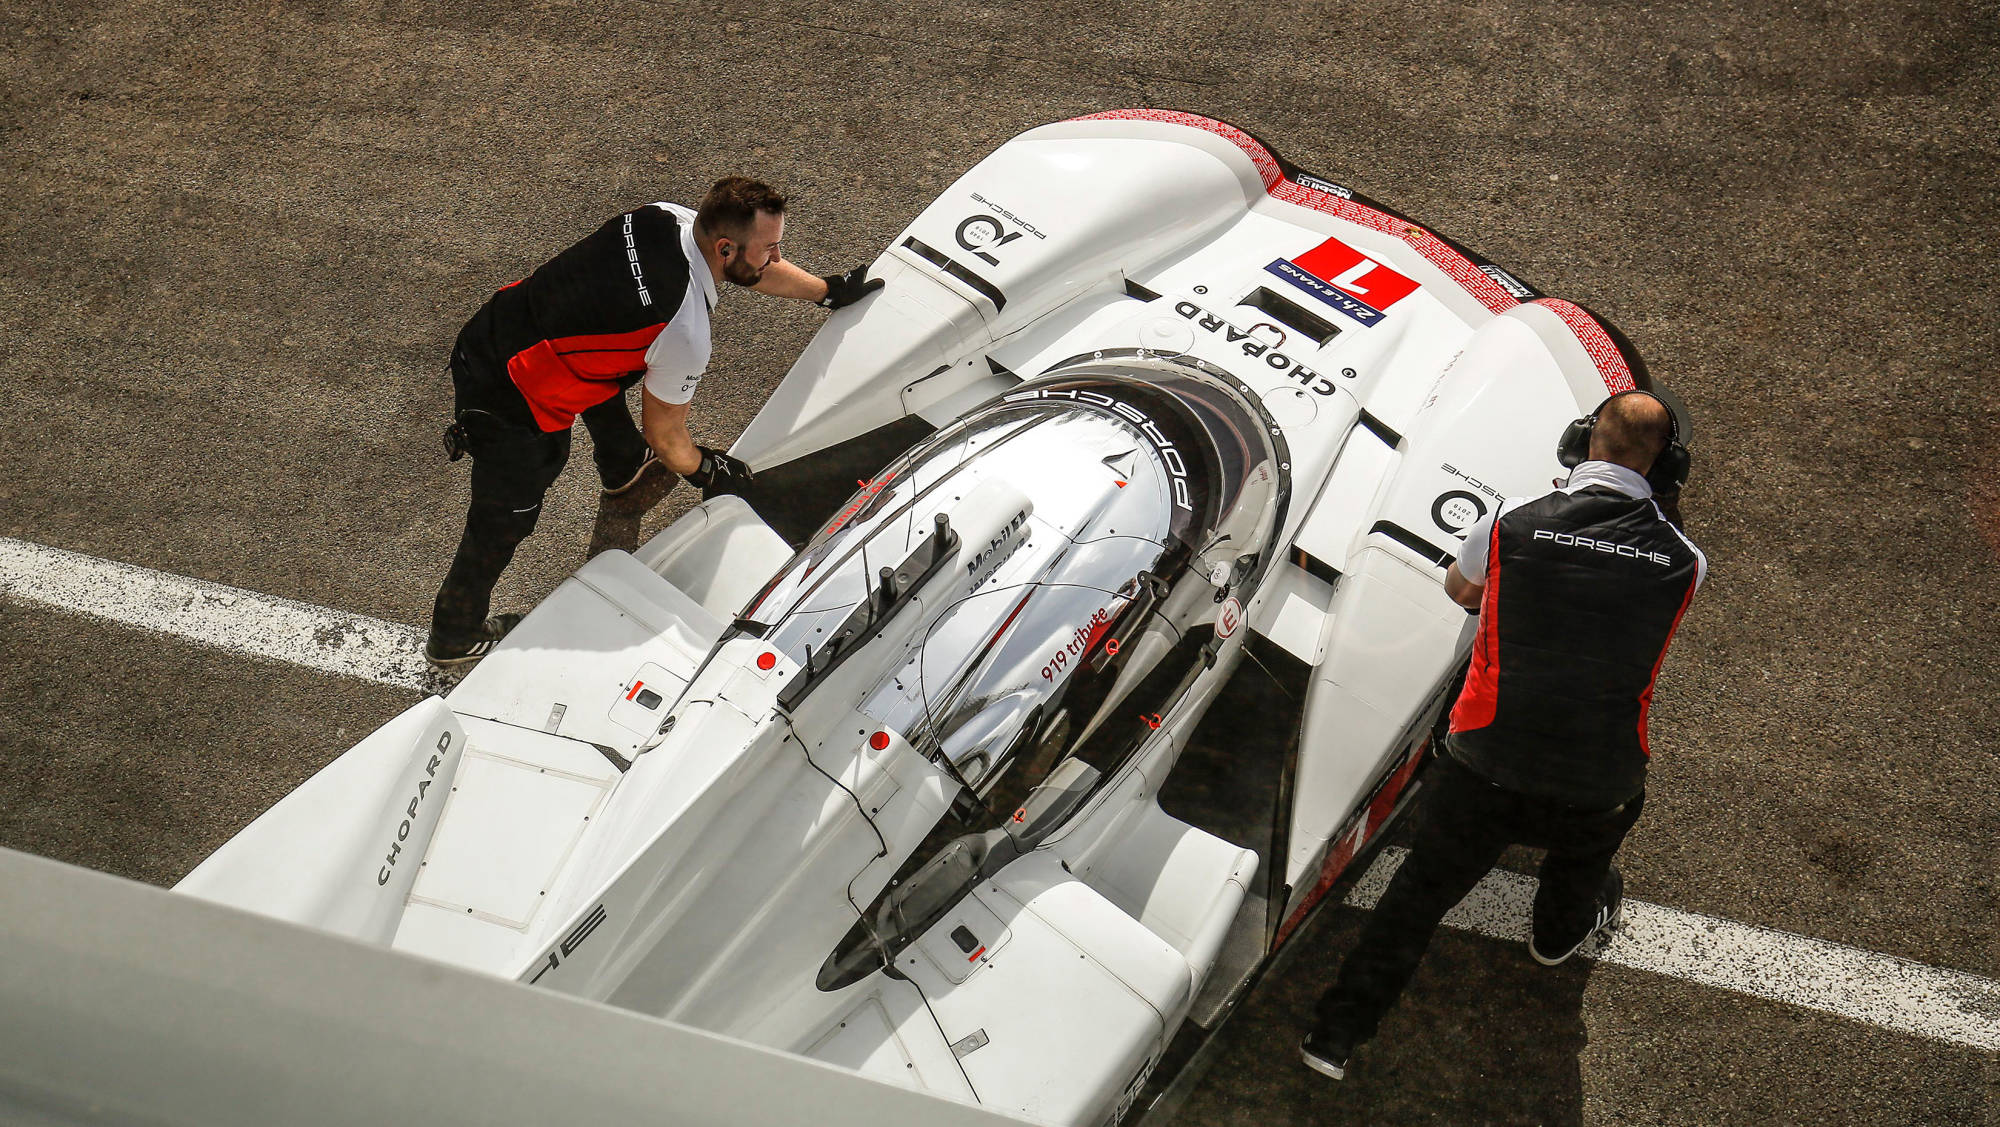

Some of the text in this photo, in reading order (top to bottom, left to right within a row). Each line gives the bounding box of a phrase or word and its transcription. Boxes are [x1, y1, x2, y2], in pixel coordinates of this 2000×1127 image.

[970, 192, 1047, 240] PORSCHE
[623, 213, 652, 307] PORSCHE
[1278, 263, 1323, 290] MANS
[1328, 258, 1379, 295] 1
[1321, 288, 1344, 301] LE
[1174, 301, 1337, 396] CHOPARD
[1003, 389, 1193, 511] PORSCHE
[967, 525, 1011, 577] Mobil
[1533, 529, 1671, 567] PORSCHE
[1041, 607, 1108, 683] 919 tribute
[377, 731, 452, 886] CHOPARD
